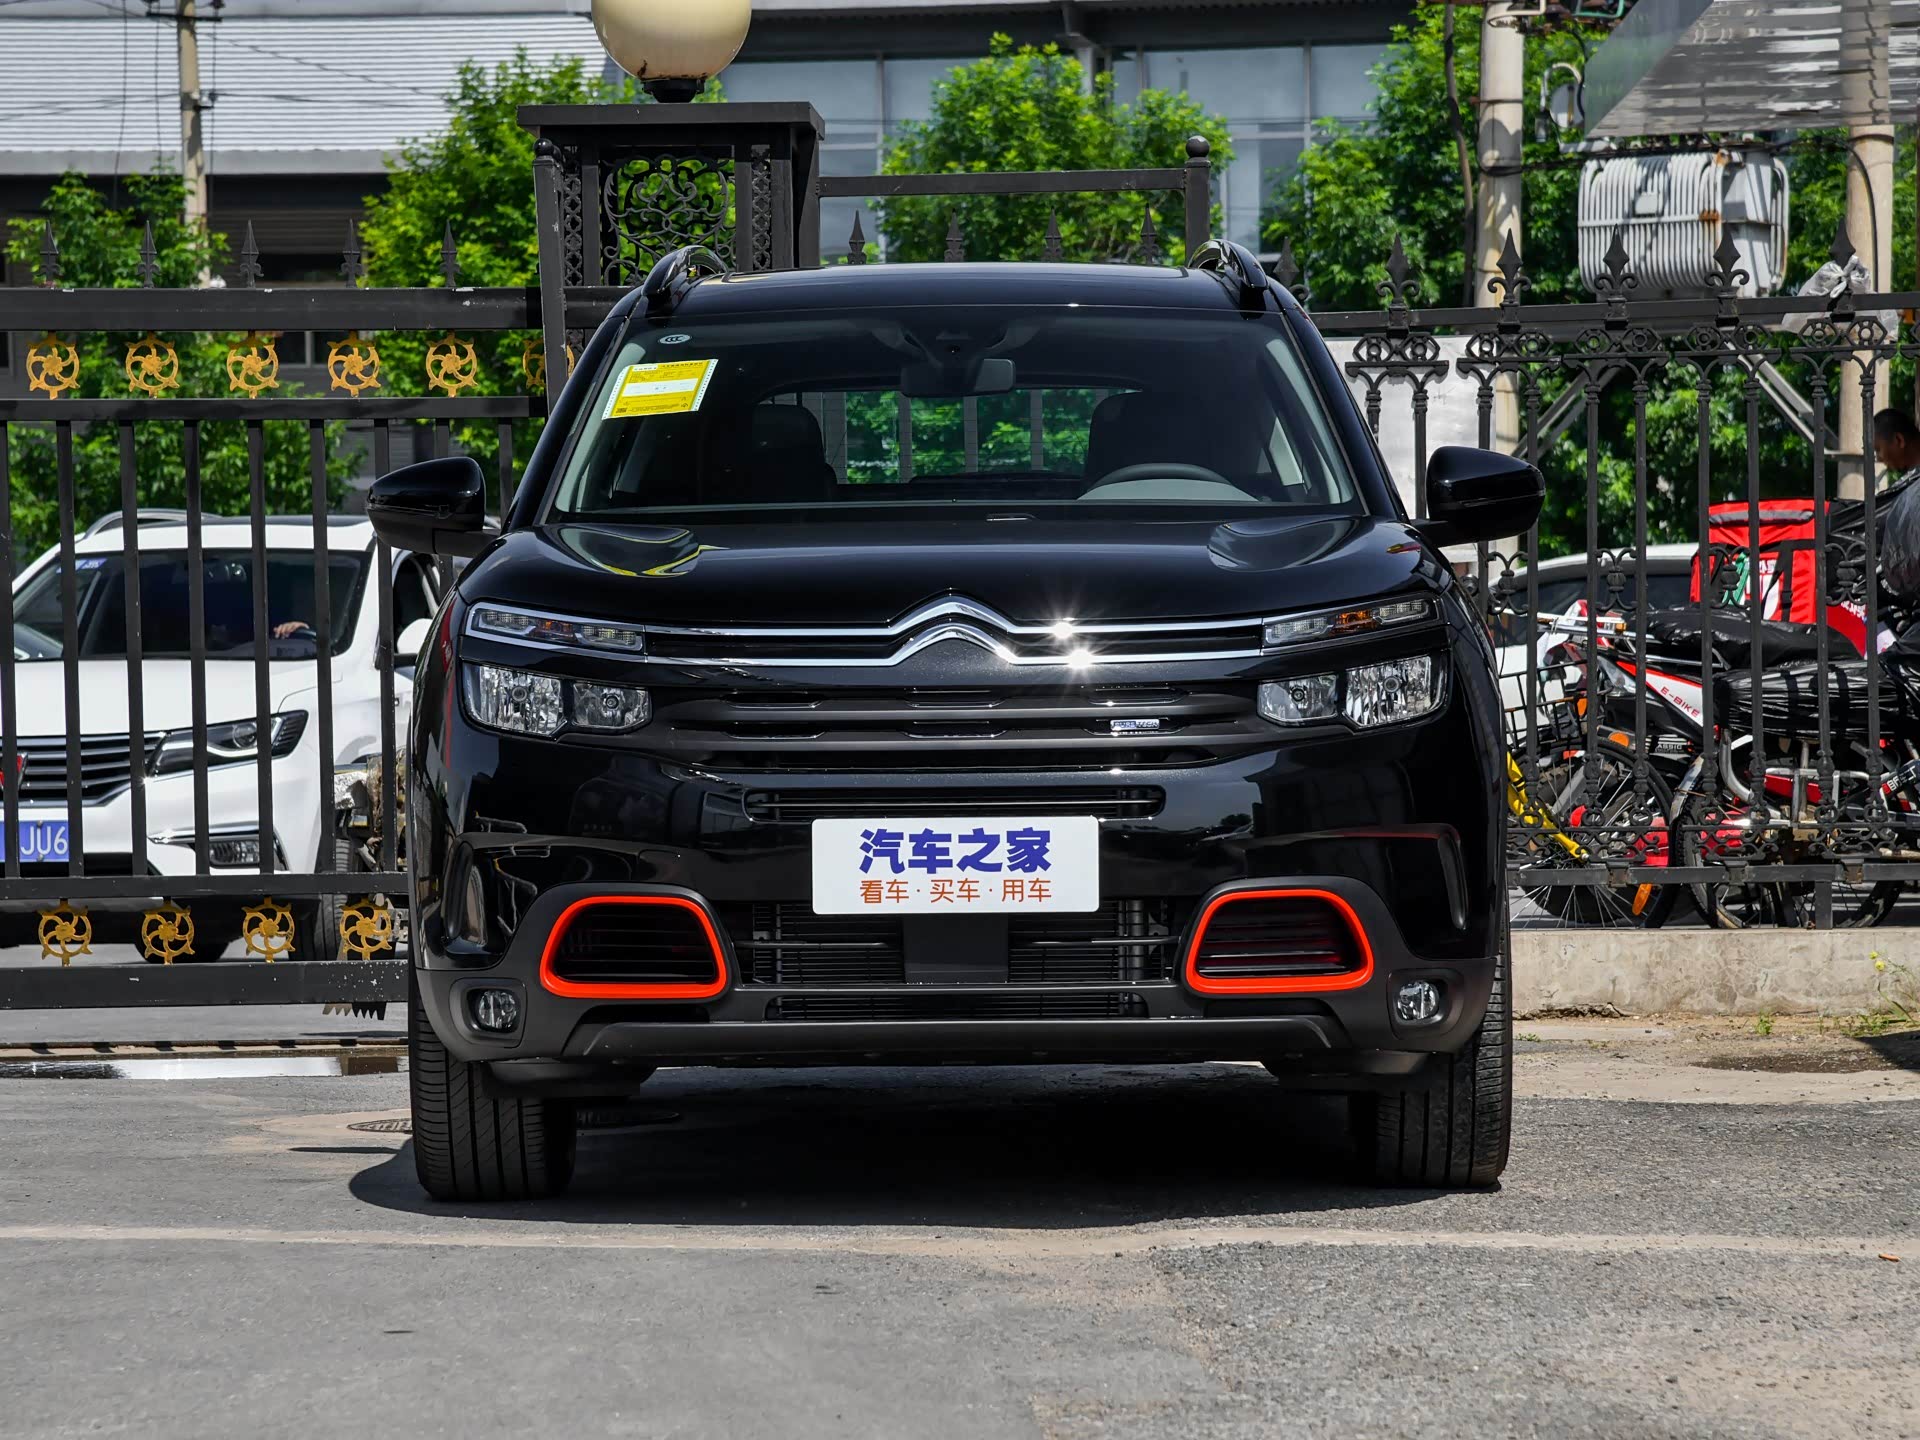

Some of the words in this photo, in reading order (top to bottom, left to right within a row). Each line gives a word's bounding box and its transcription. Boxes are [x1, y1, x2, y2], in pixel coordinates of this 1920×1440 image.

[1660, 686, 1701, 718] E-BIKE
[859, 827, 1052, 875] 汽车之家
